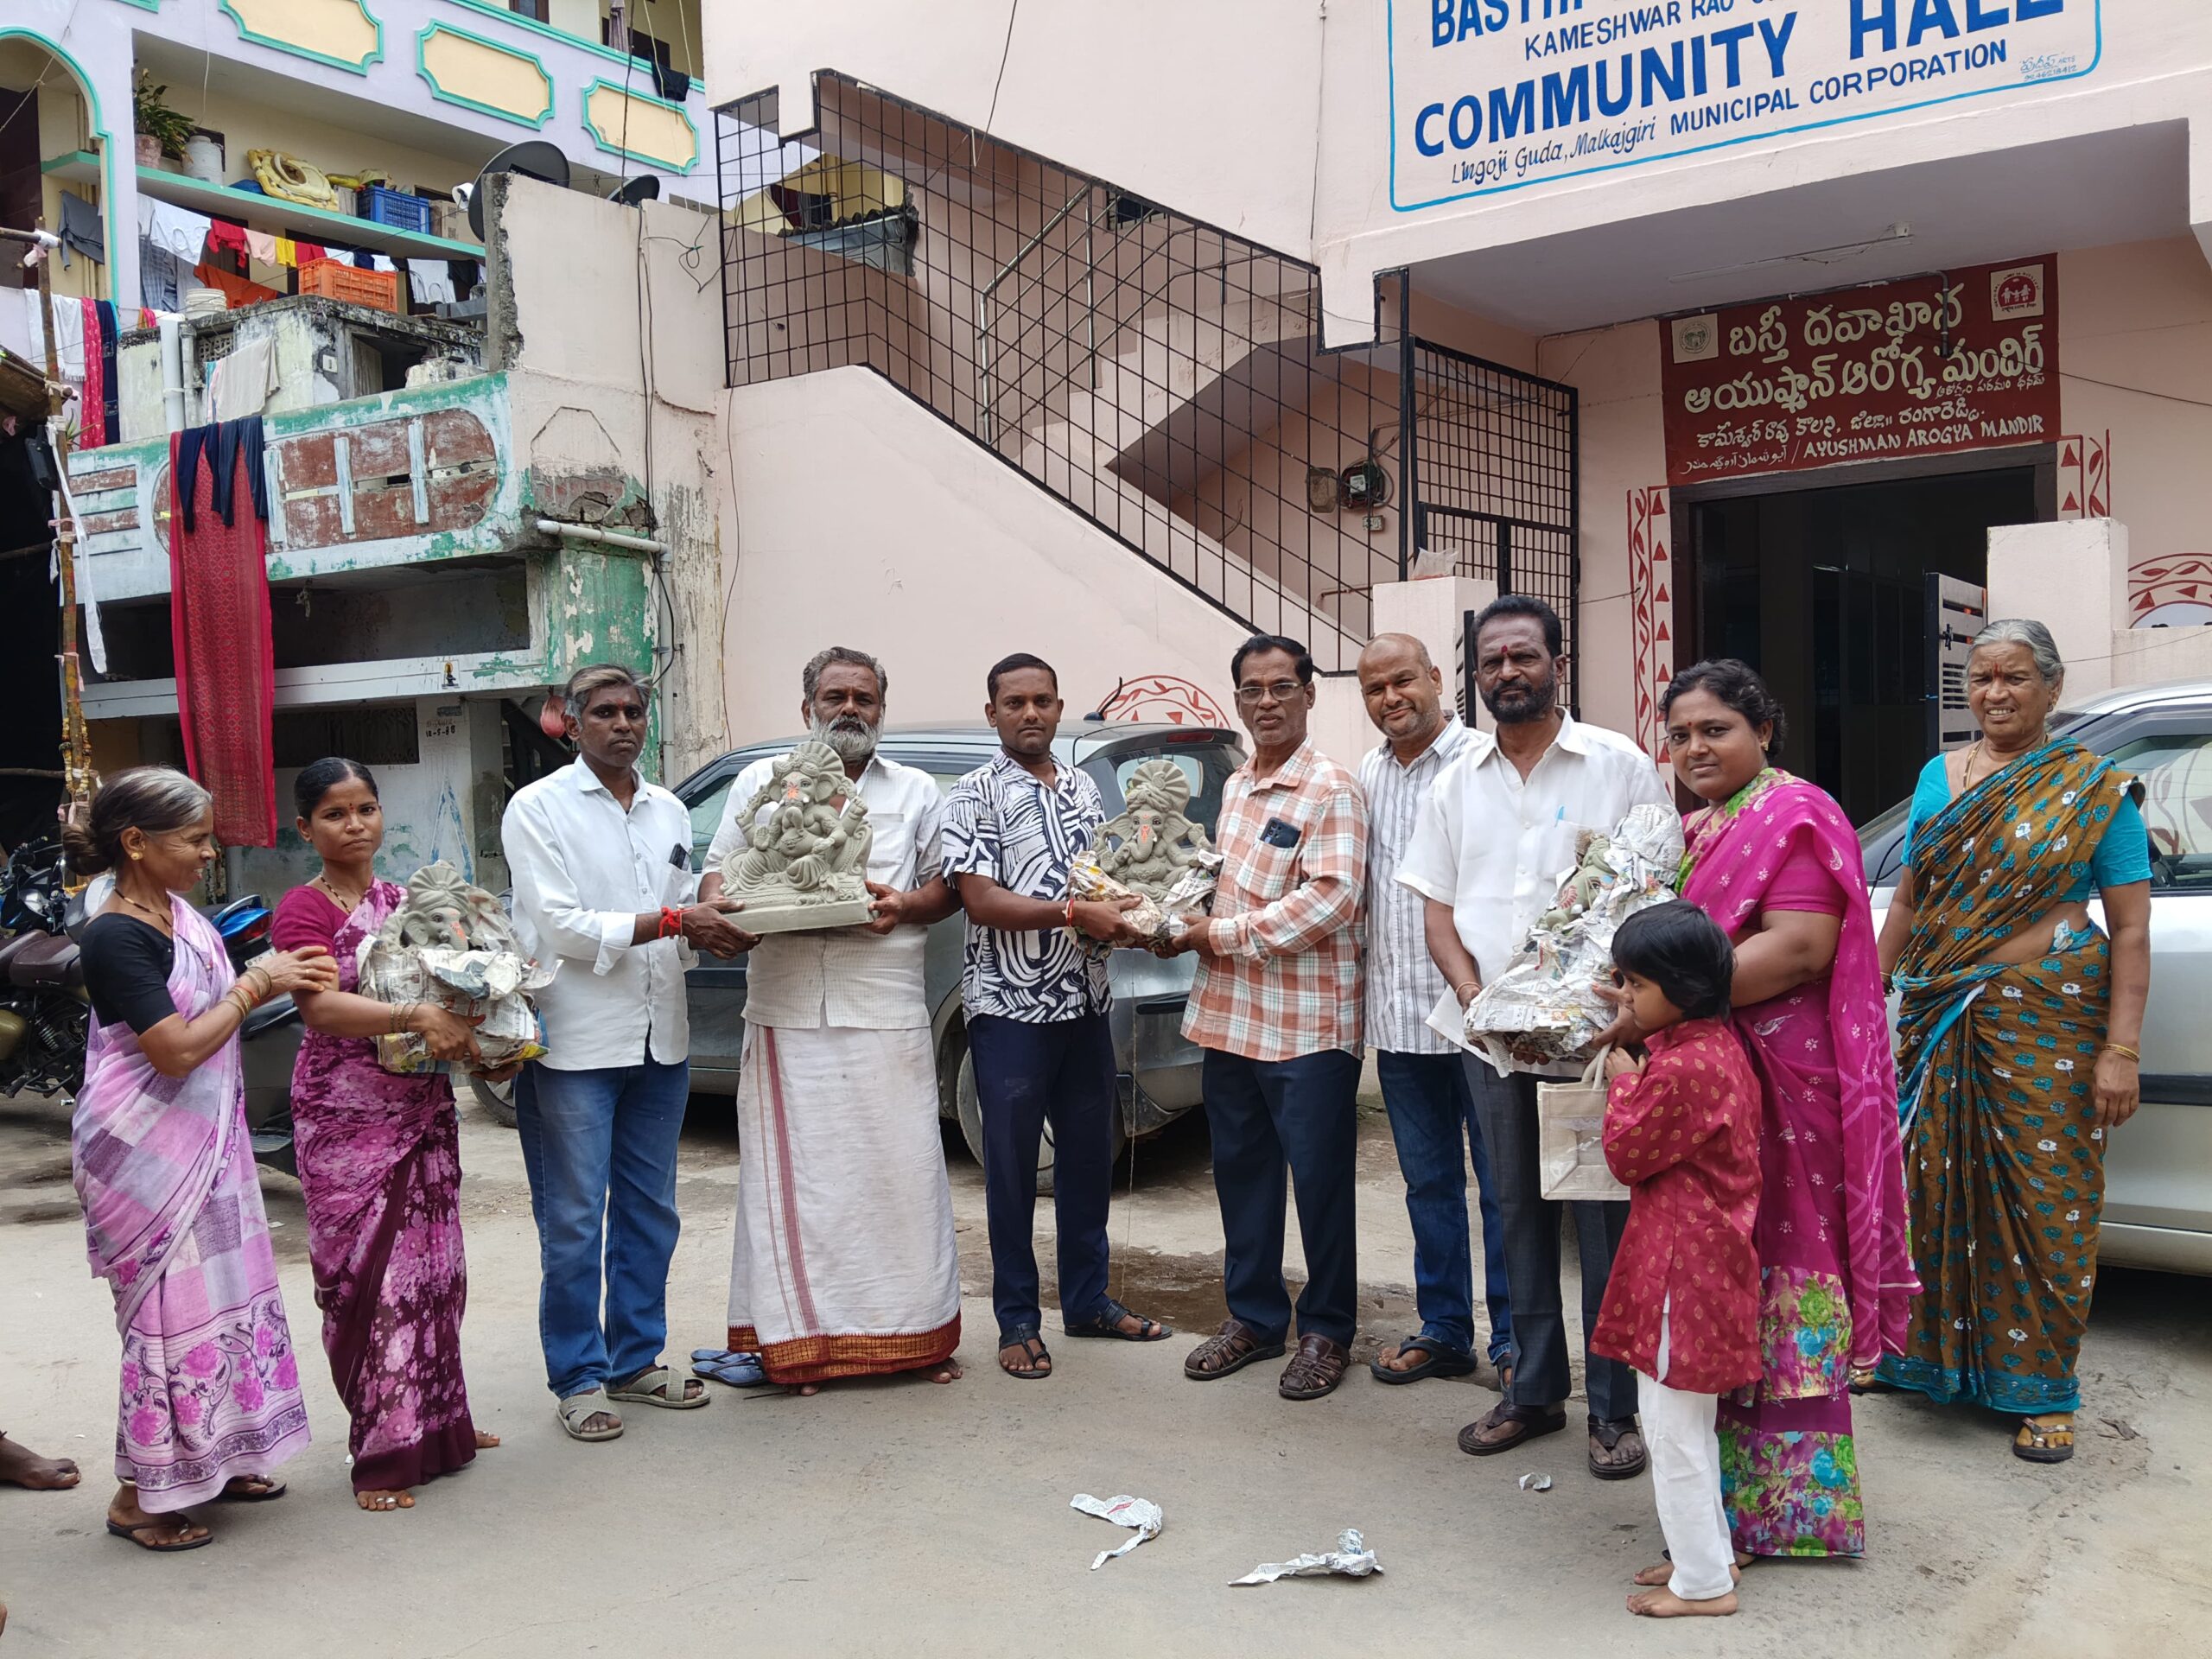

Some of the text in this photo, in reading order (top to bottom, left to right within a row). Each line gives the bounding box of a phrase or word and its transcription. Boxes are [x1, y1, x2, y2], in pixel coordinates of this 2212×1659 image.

[1432, 0, 1583, 48] BAS
[1525, 1, 1681, 60] KAMESHWAR
[1414, 11, 1798, 157] COMMUNITY
[1452, 39, 2007, 185] Lingoji Guda, Malkajgiri MUNICIPAL CORPORATION
[1728, 304, 1789, 363] బస్తీ
[1803, 283, 1964, 346] దవాఖాన
[1684, 353, 1838, 414] ఆయుష్మాన్
[1840, 338, 1937, 400] ఆరోగ్య
[1803, 434, 1901, 458] AYUSHMAN
[1906, 423, 1974, 448] AROGYA
[1981, 414, 2044, 438] MANDIR
